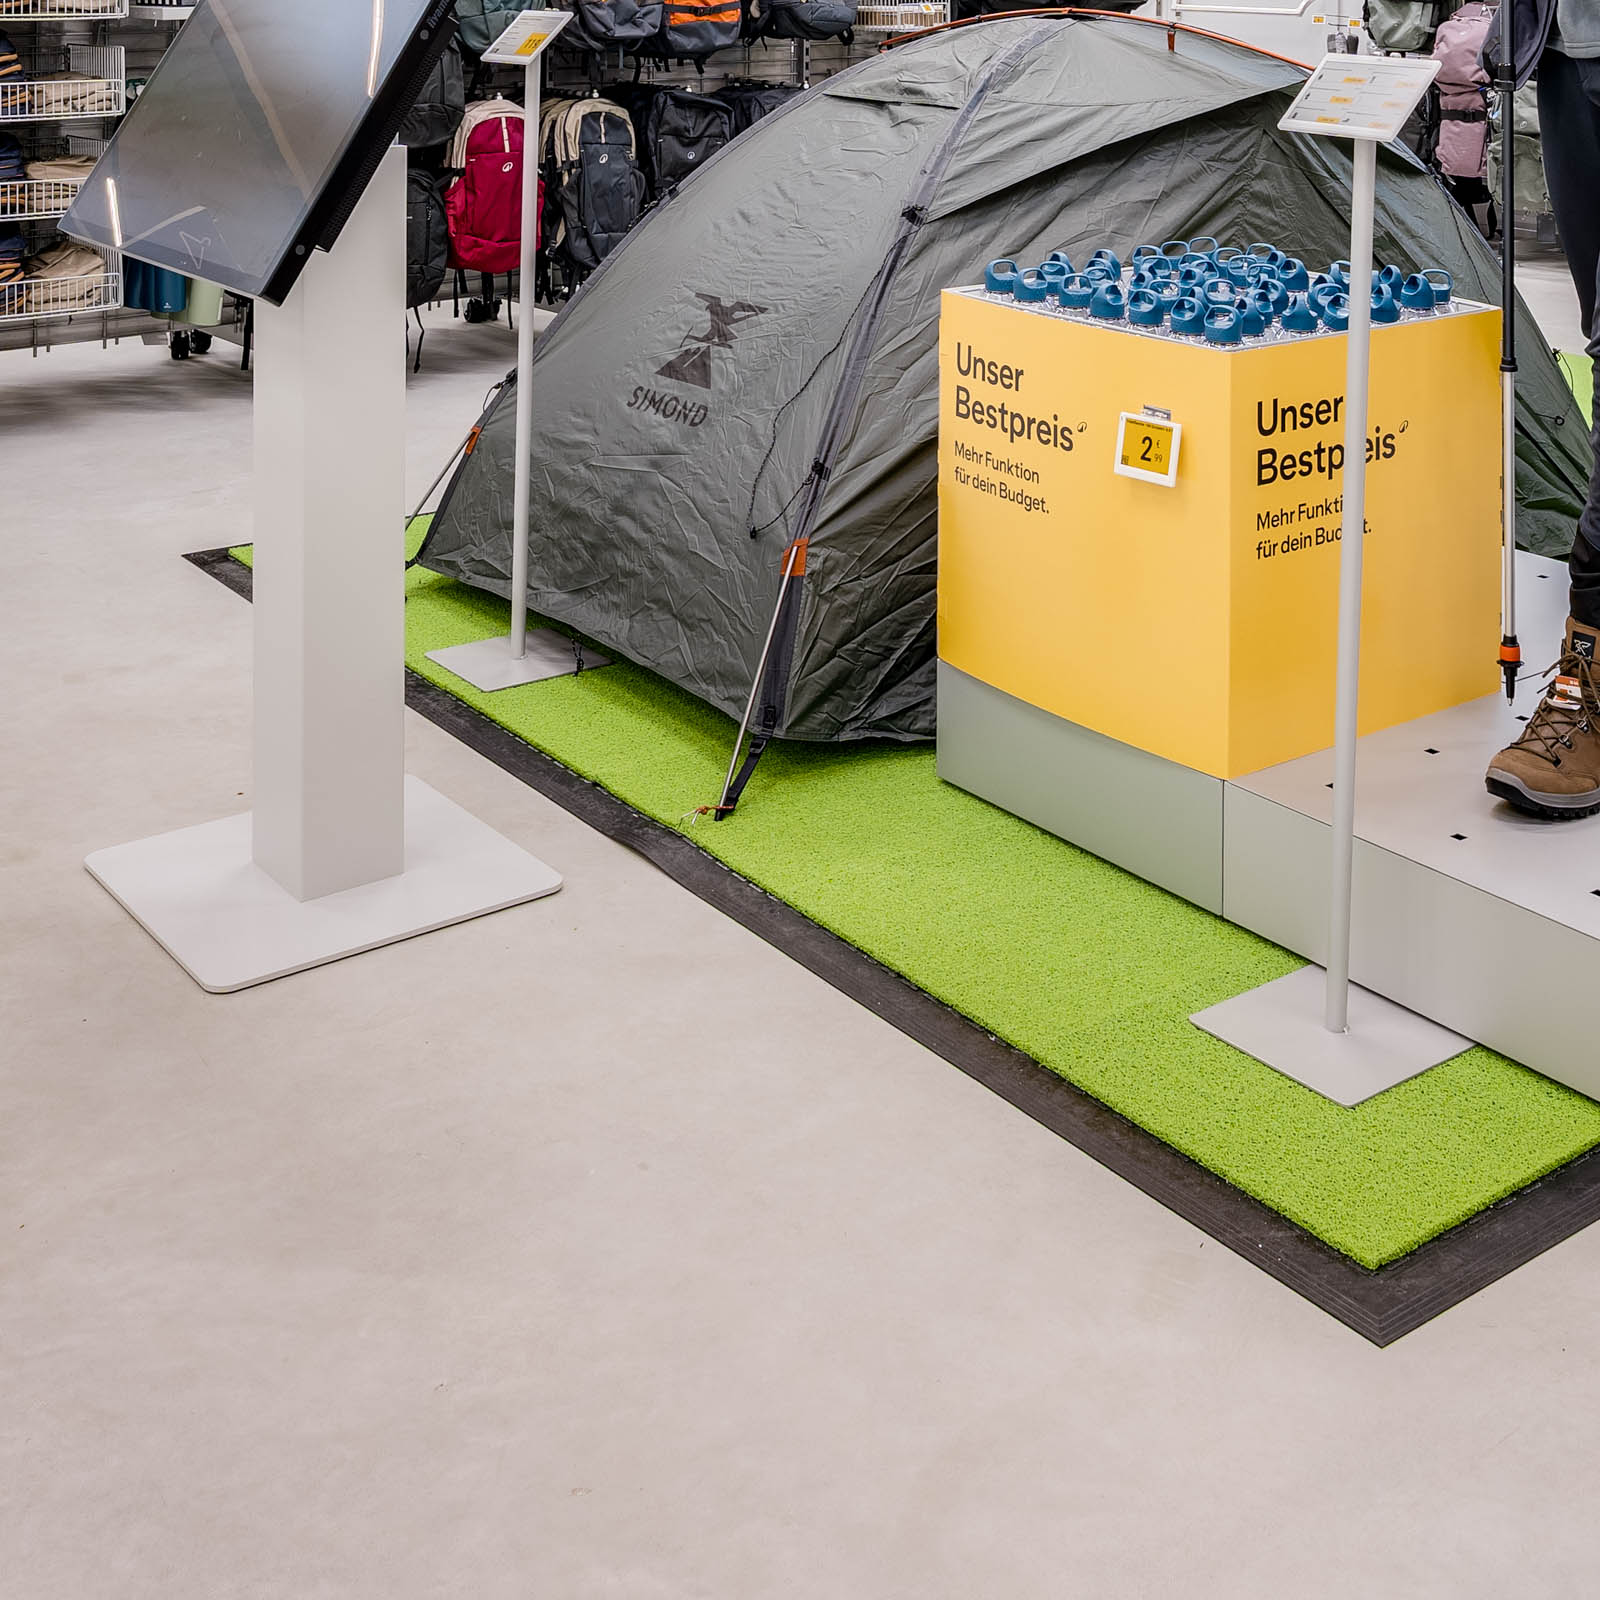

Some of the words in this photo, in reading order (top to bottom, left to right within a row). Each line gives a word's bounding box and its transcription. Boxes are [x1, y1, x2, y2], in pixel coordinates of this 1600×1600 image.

[957, 342, 1024, 392] Unser
[626, 385, 709, 428] SIMOND
[955, 385, 1074, 451] Bestpreis
[1257, 396, 1344, 437] Unser
[954, 440, 983, 465] Mehr
[985, 451, 1040, 484] Funktion
[1257, 426, 1396, 486] Bestpeis
[954, 466, 971, 486] für
[972, 471, 997, 496] dein
[999, 482, 1050, 514] Budget.
[1256, 508, 1296, 531] Mehr
[1298, 494, 1343, 522] Funkti
[1256, 540, 1279, 560] für
[1280, 532, 1312, 554] dein
